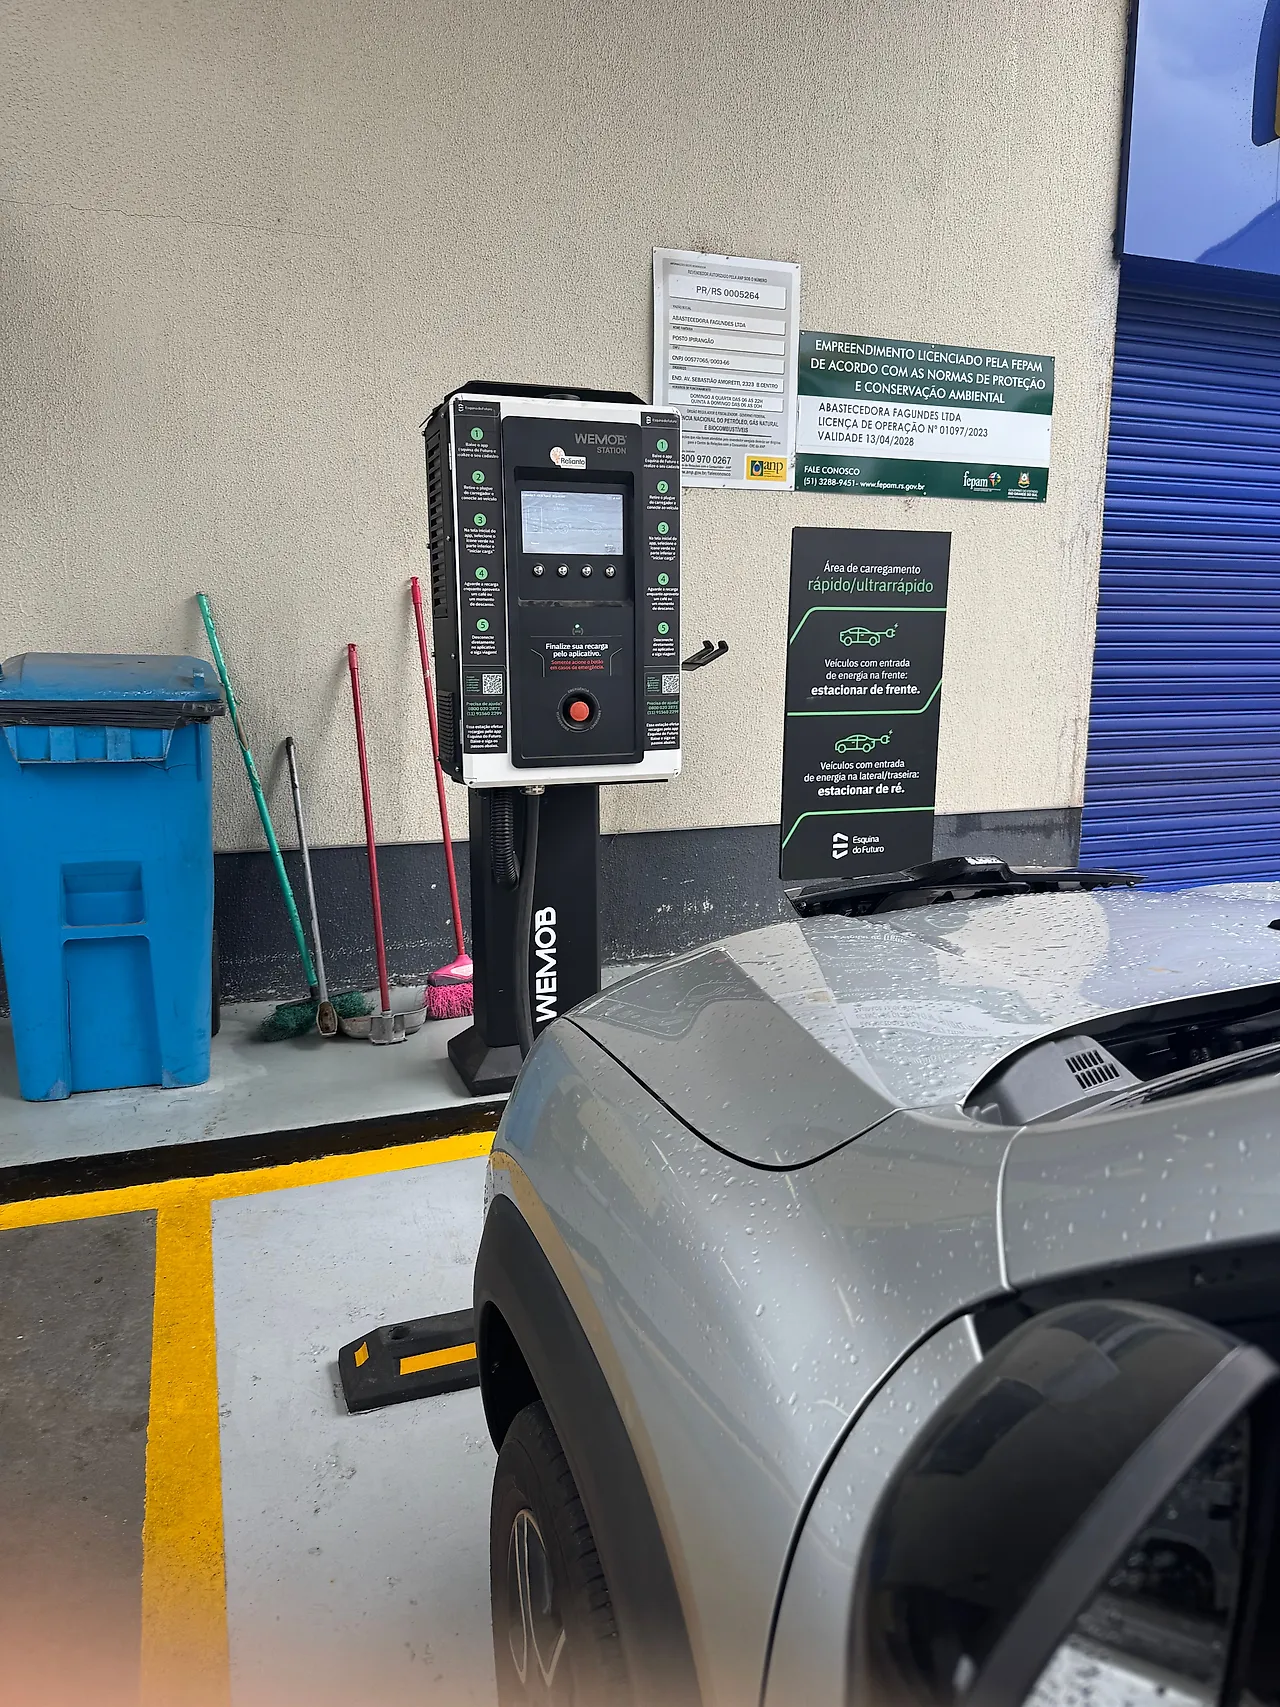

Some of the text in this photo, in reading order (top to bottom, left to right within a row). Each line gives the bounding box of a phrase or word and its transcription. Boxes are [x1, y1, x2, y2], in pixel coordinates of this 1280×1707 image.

[696, 286, 759, 300] PR/RS 0005264
[672, 315, 709, 323] ABASTECEDORA
[709, 319, 733, 327] FAGUNDES
[815, 339, 1042, 372] EMPREENDIMENTO LICENCIADO PELA FEPAM
[692, 376, 717, 384] SEBASTIÃO
[810, 358, 1046, 390] DE ACORDO COM AS NORMAS DE PROTEÇÃO
[855, 381, 1005, 404] E CONSERVAÇÃO AMBIENTAL
[819, 402, 961, 422] ABASTECEDORA FAGUNDES LTDA
[694, 416, 715, 424] NACIONAL
[818, 417, 858, 430] LICENÇA
[862, 420, 872, 430] DE
[875, 420, 925, 434] OPERAÇÃO
[939, 425, 988, 437] 01097/2023
[575, 433, 626, 445] WEMOB
[818, 431, 914, 447] VALIDADE 13/04/2028
[682, 454, 732, 465] 800 970 0267
[763, 461, 783, 474] anp
[804, 466, 860, 476] FALE CONOSCO
[803, 477, 817, 486] (51)
[860, 481, 925, 491] www.fepam.rs.gov.br
[963, 471, 988, 489] fepam
[824, 560, 921, 575] Área de carregamento
[808, 576, 933, 595] rápido/ultrarrápido
[553, 650, 601, 658] pelo aplicativo.
[824, 659, 858, 667] Veículos
[879, 659, 910, 667] entrada
[826, 671, 837, 680] de
[838, 671, 868, 681] energia
[881, 671, 908, 679] frente:
[811, 684, 921, 695] estacionar de frente.
[820, 761, 854, 770] Veículos
[874, 759, 905, 768] entrada
[804, 773, 815, 782] de
[816, 772, 846, 783] energia
[859, 771, 920, 781] lateral/traseira:
[818, 782, 905, 796] estacionar de ré.
[852, 835, 879, 844] Esquina
[535, 906, 557, 1022] WEMOB
